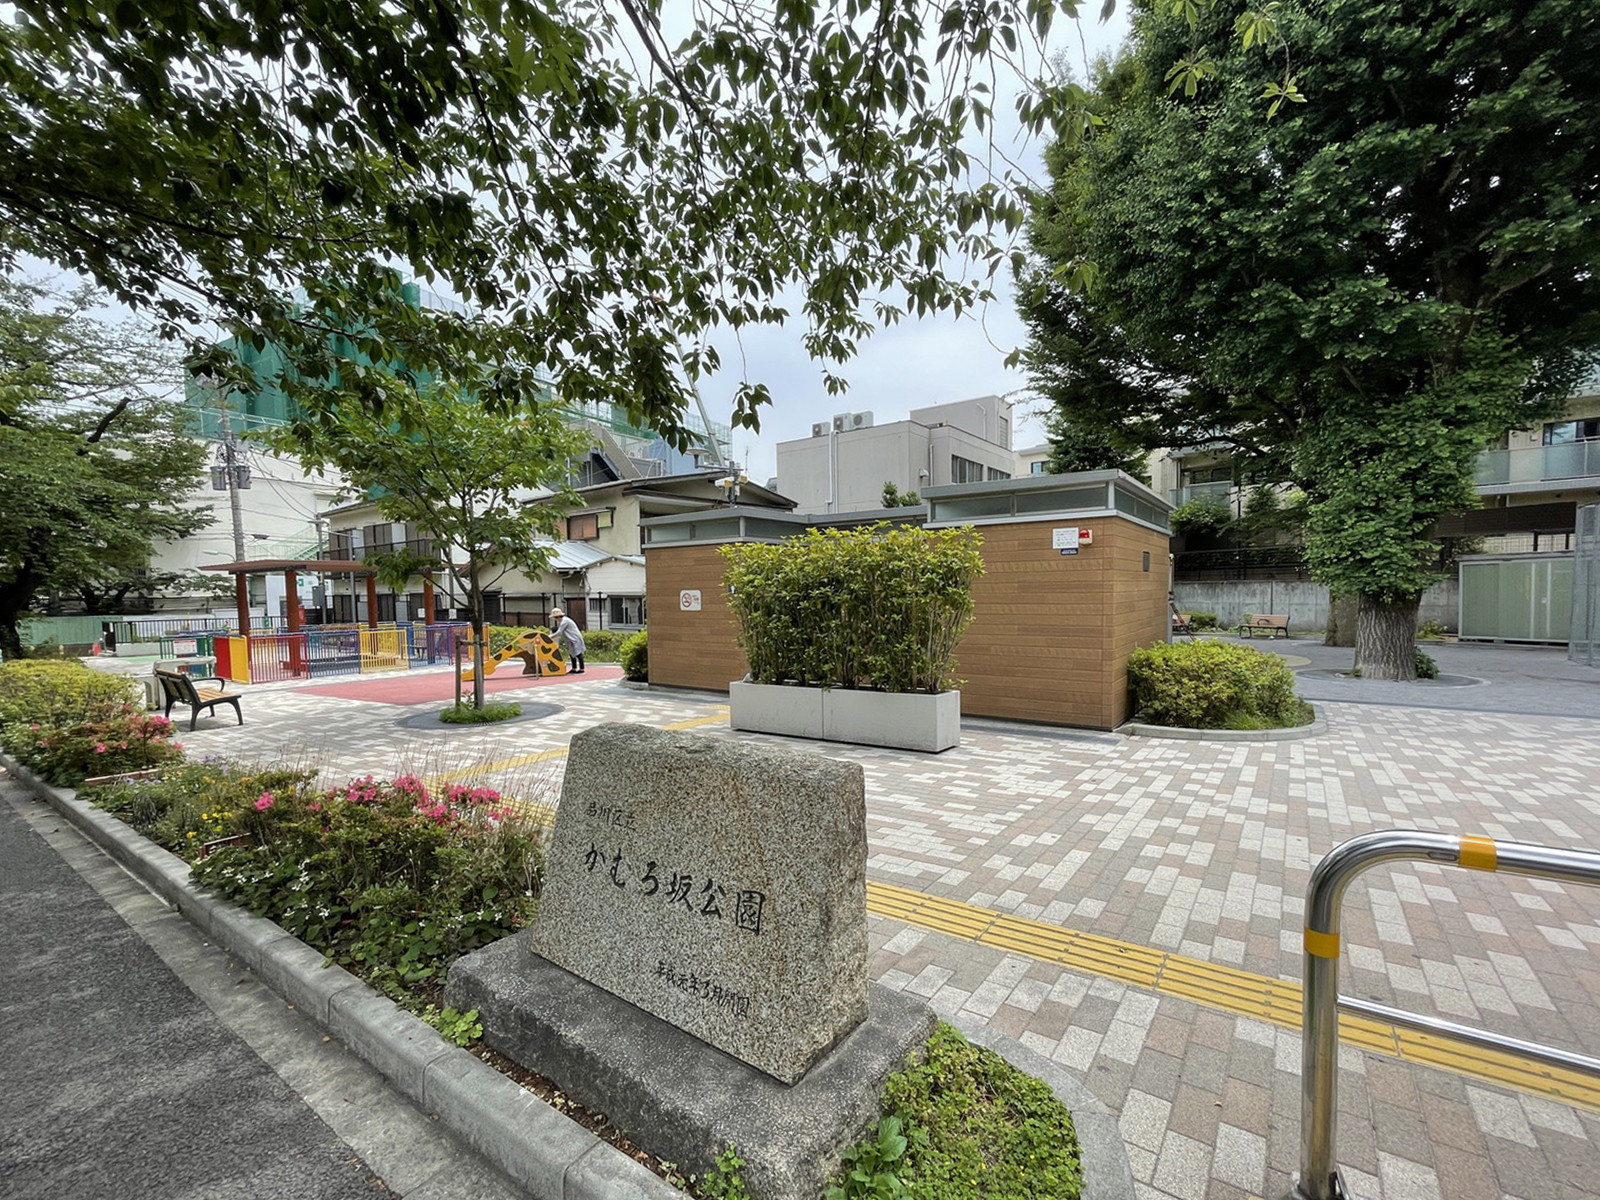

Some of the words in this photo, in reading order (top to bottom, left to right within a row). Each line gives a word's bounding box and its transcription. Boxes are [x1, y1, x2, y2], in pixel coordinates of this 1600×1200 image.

[585, 842, 765, 936] かむろ坂公園
